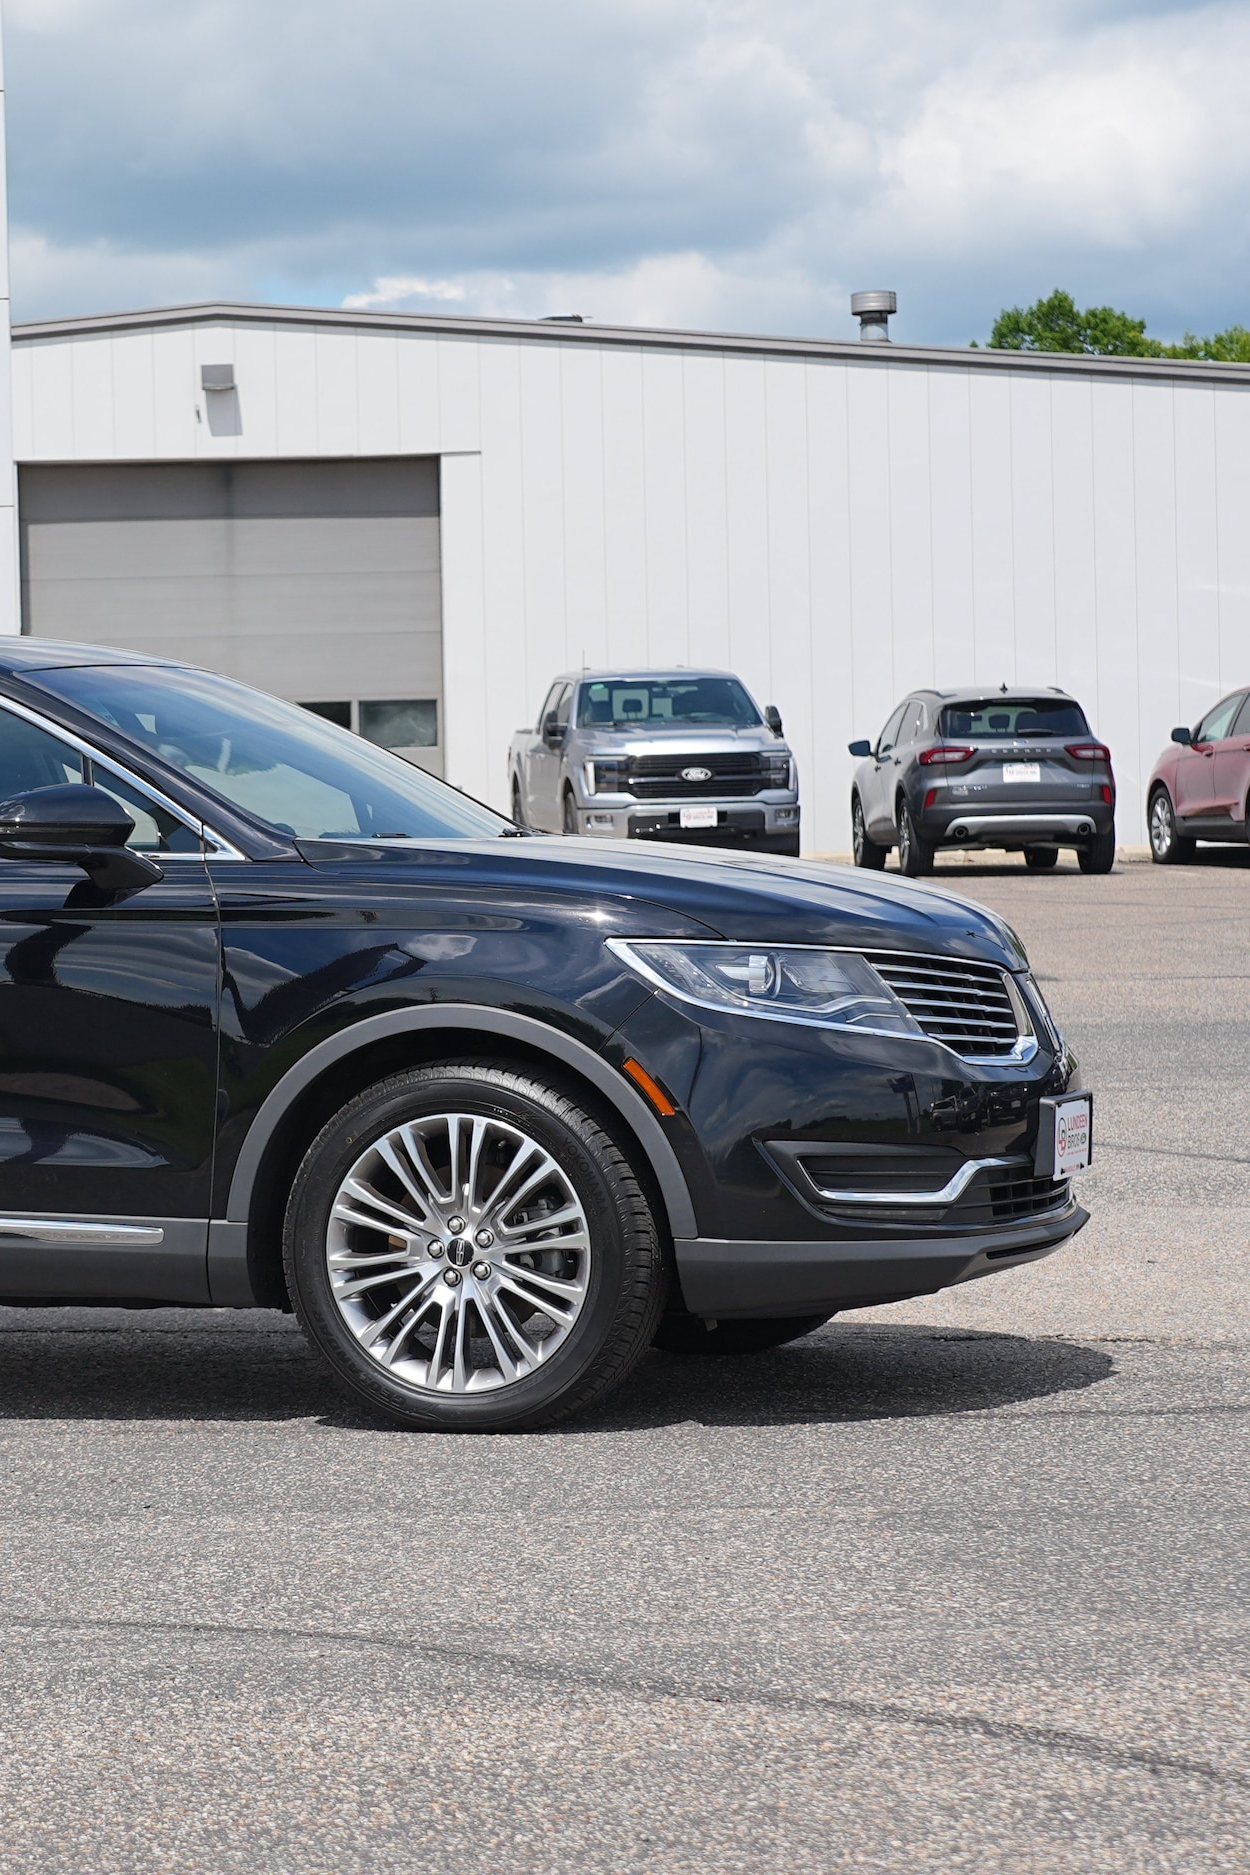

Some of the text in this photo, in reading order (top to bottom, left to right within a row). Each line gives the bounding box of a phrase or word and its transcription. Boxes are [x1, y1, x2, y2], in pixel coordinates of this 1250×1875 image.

[1067, 1113, 1088, 1131] LUNDEEN
[1067, 1132, 1080, 1149] BROS
[561, 1136, 609, 1216] YOKOHAMA
